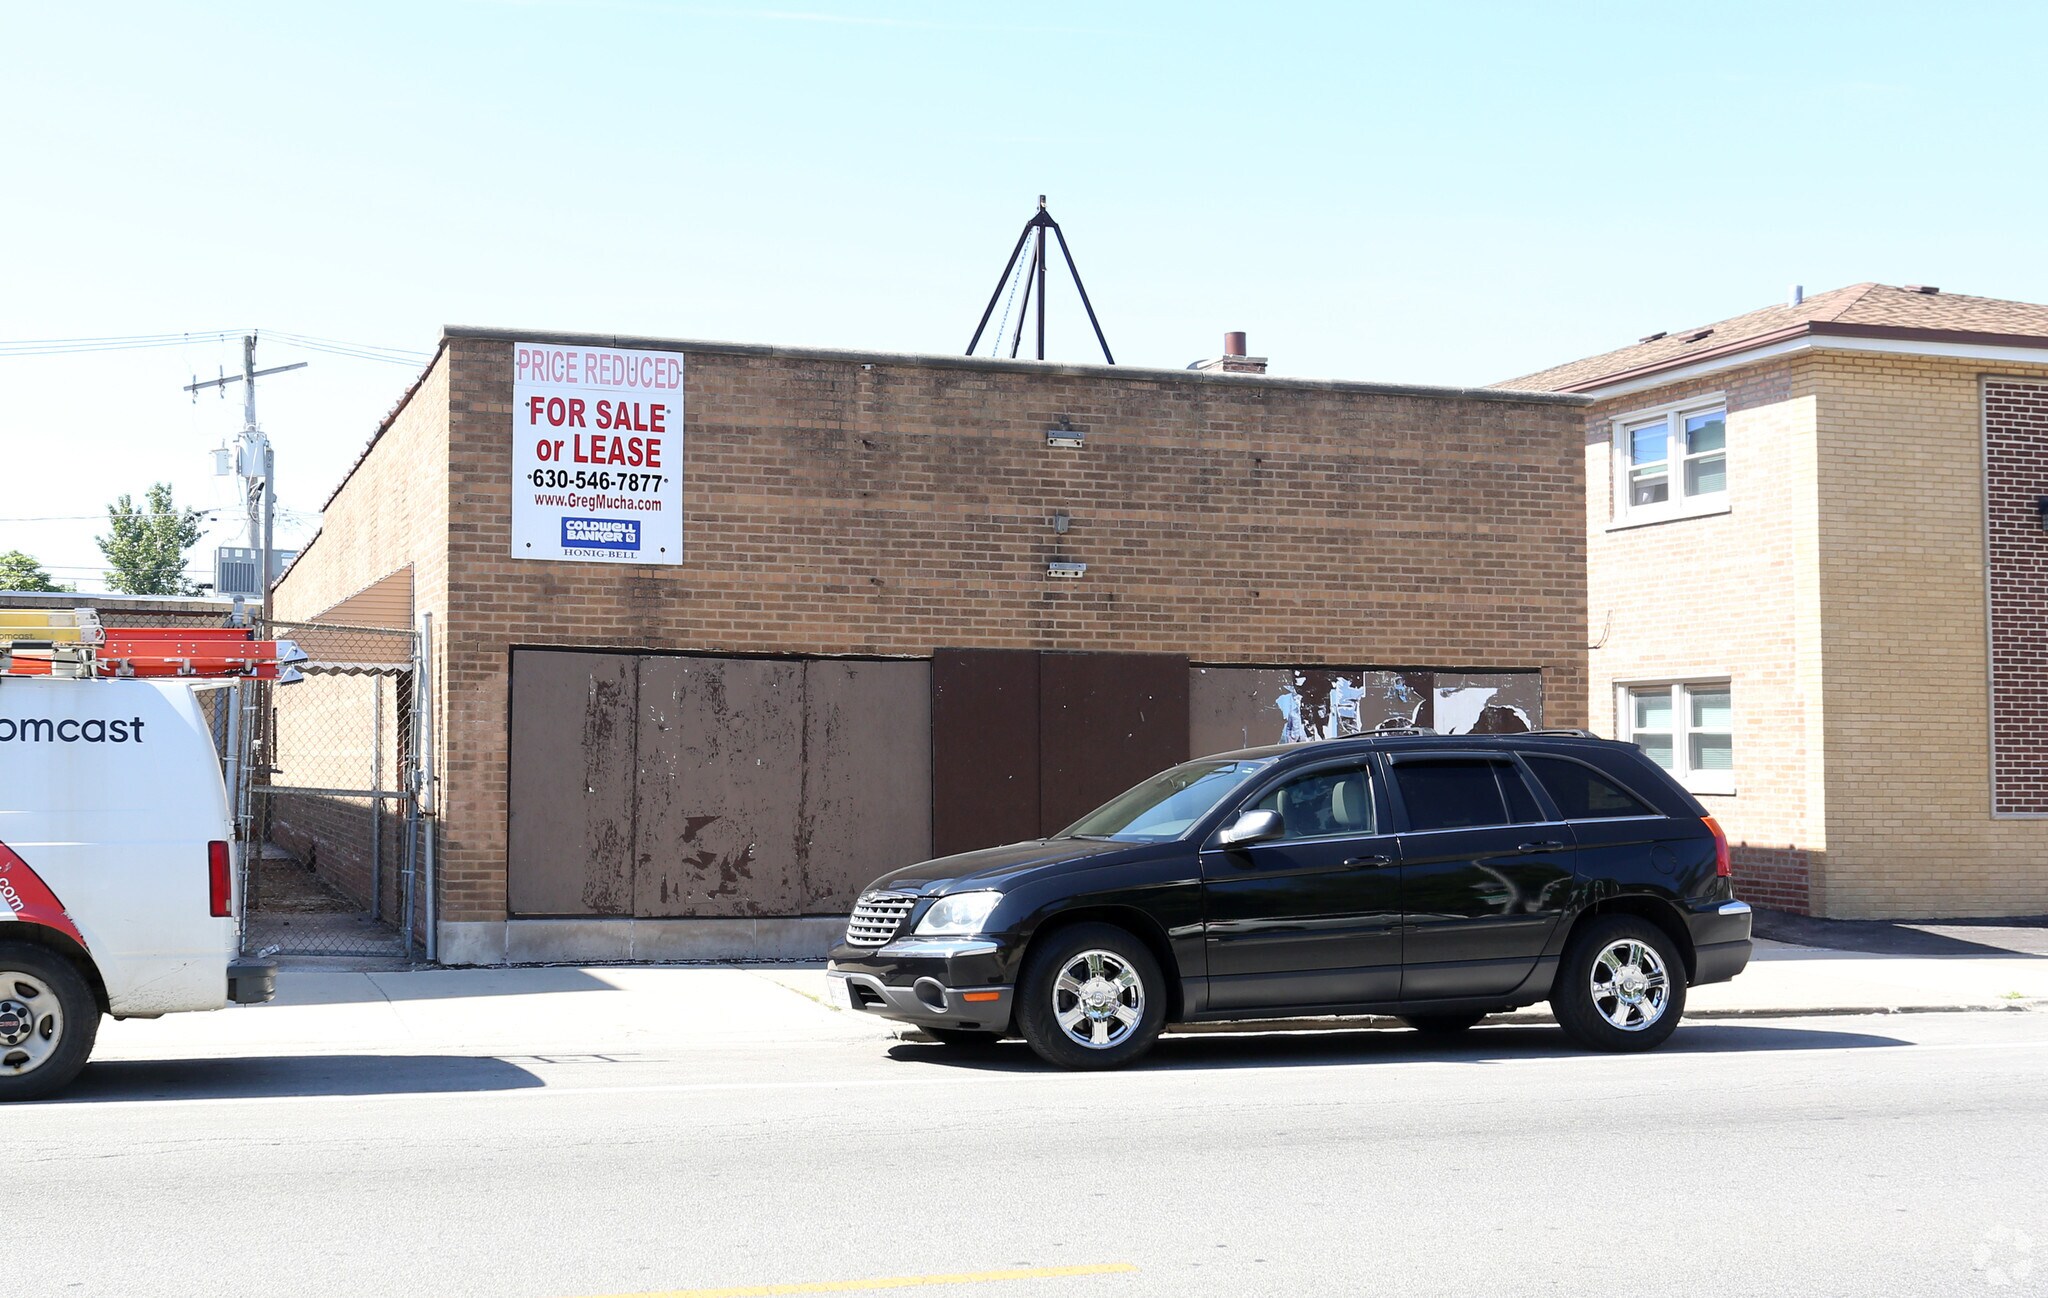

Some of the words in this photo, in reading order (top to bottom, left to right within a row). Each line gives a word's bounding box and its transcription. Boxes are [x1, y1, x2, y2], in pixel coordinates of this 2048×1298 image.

[518, 349, 578, 384] PRICE
[585, 353, 680, 389] REDUCED
[530, 396, 586, 428] FOR
[595, 400, 666, 433] SALE
[536, 439, 565, 462] or
[574, 434, 661, 468] LEASE
[533, 469, 662, 493] 630-546-7877
[534, 492, 662, 512] www.GregMucha.com
[564, 549, 638, 559] HONIG-BELL
